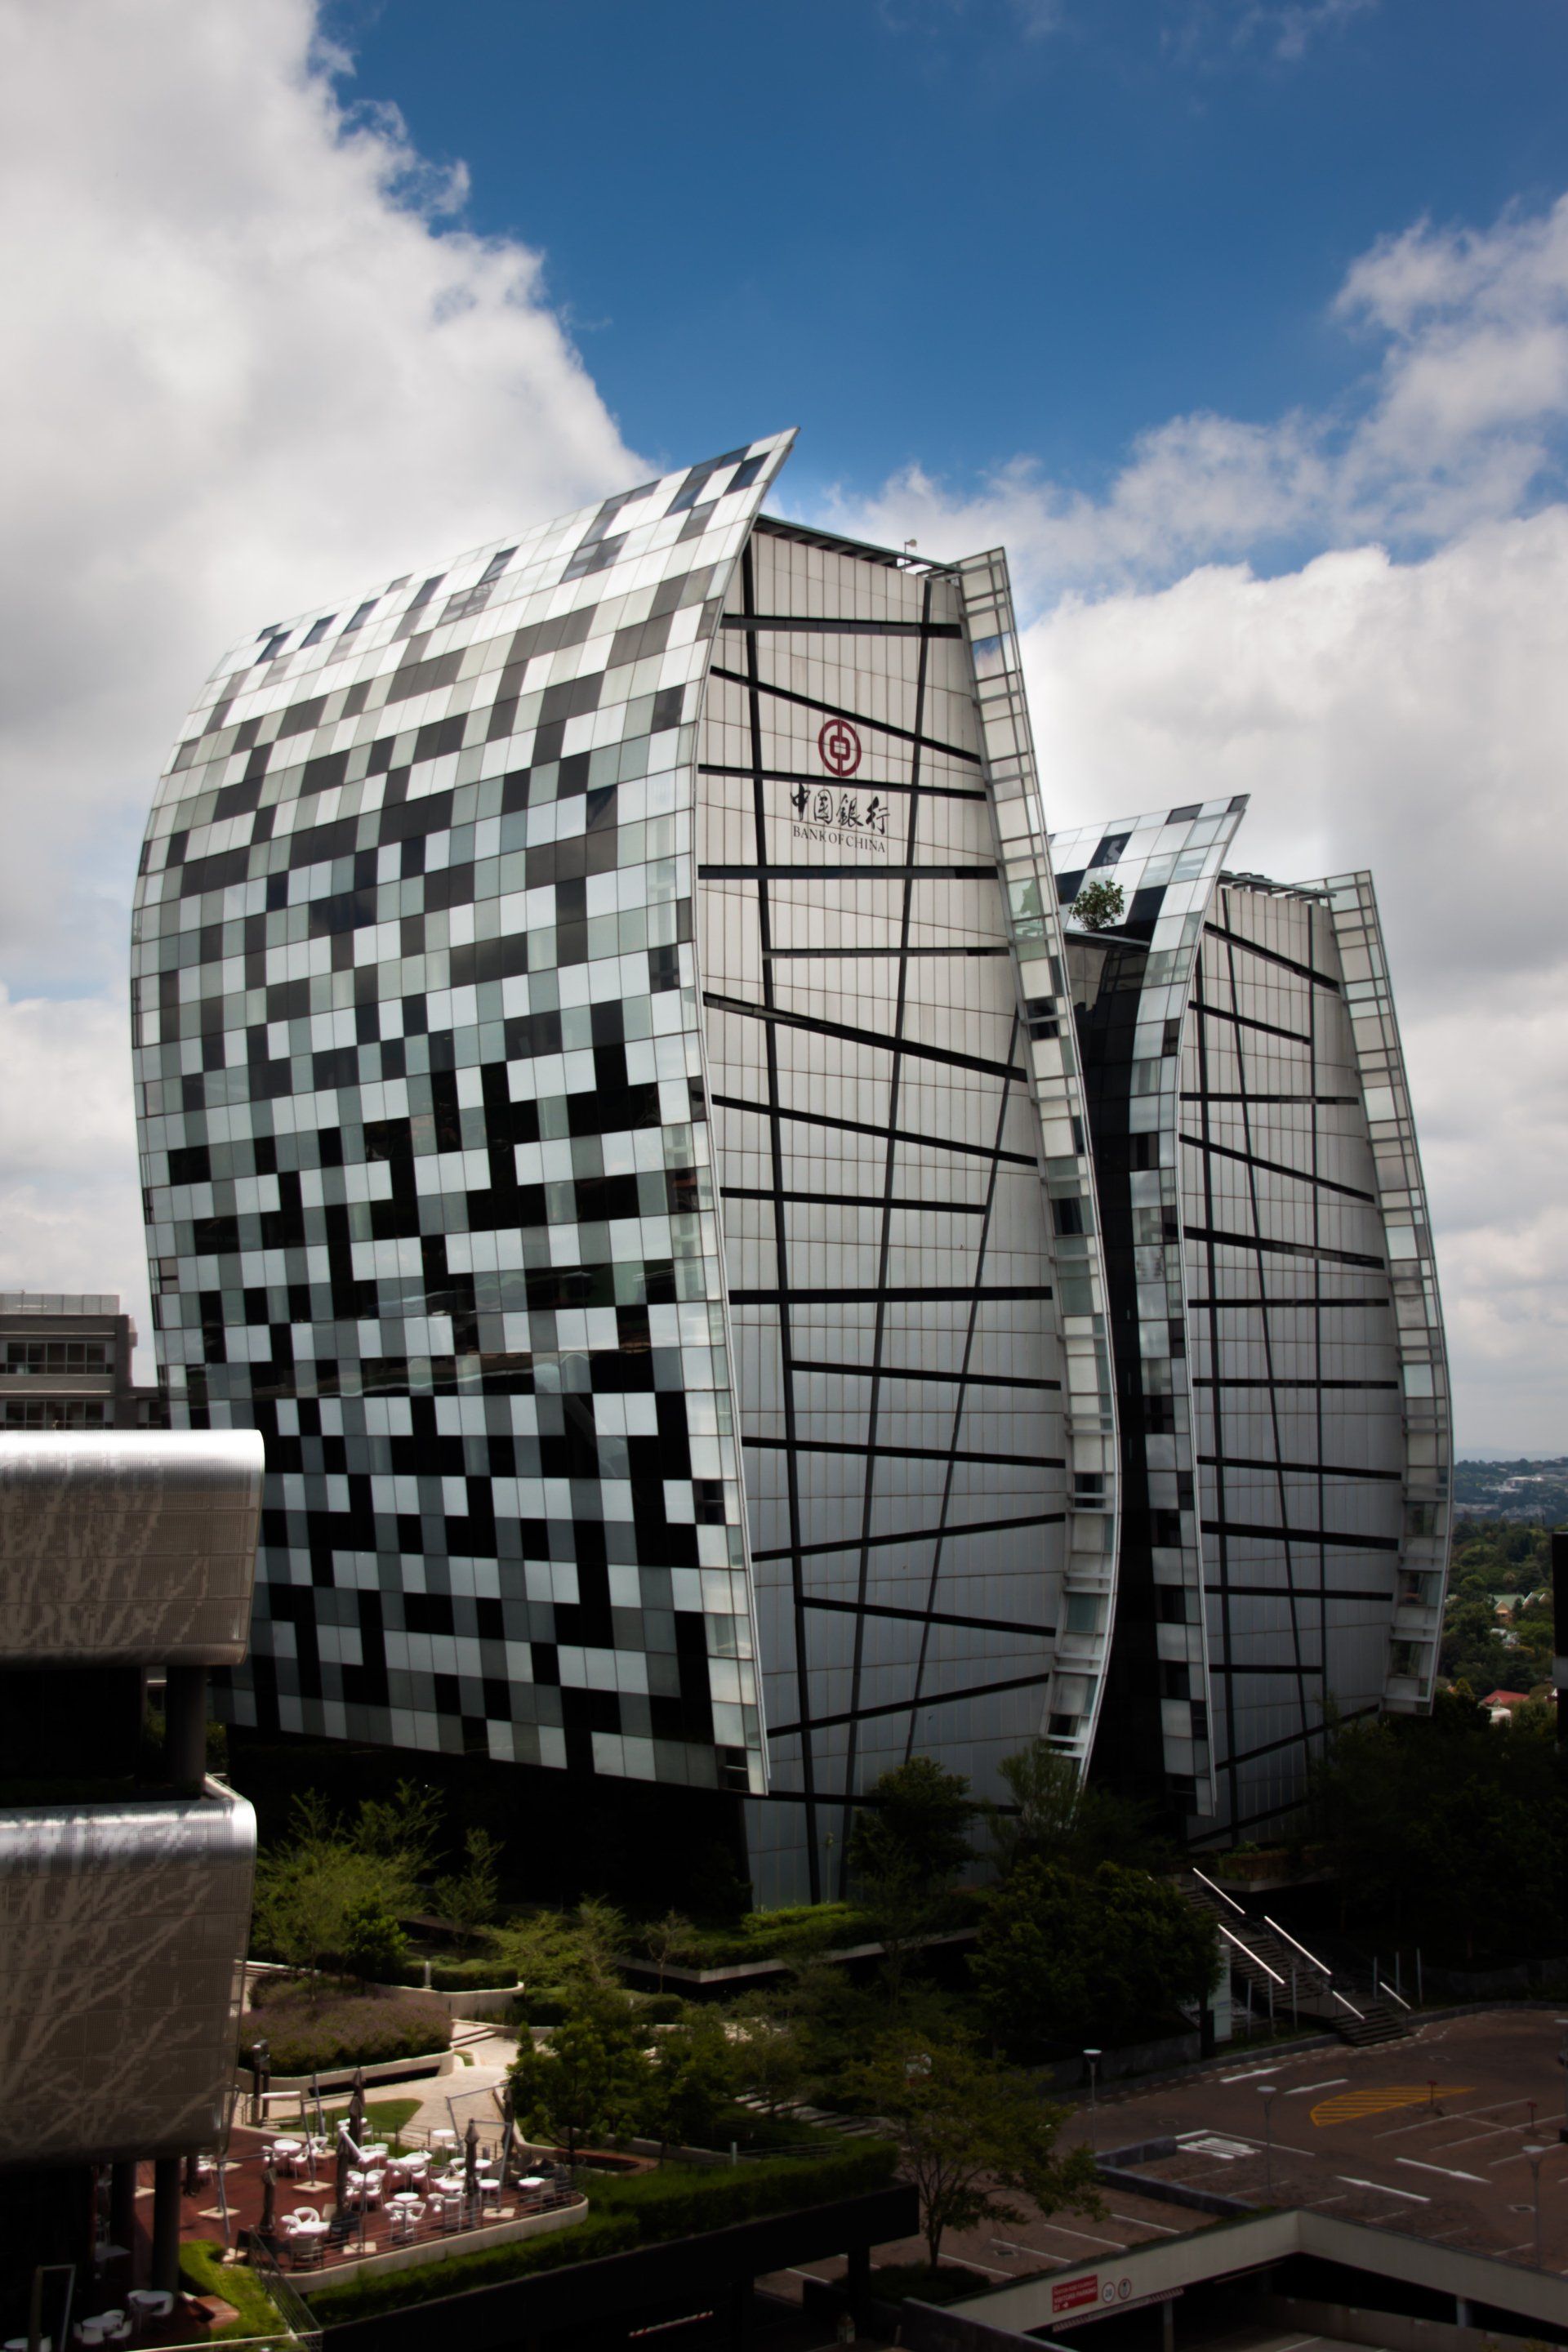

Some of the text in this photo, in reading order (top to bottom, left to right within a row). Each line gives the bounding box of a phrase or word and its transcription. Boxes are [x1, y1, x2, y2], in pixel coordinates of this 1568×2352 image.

[793, 825, 885, 853] BANK OF CHINA
